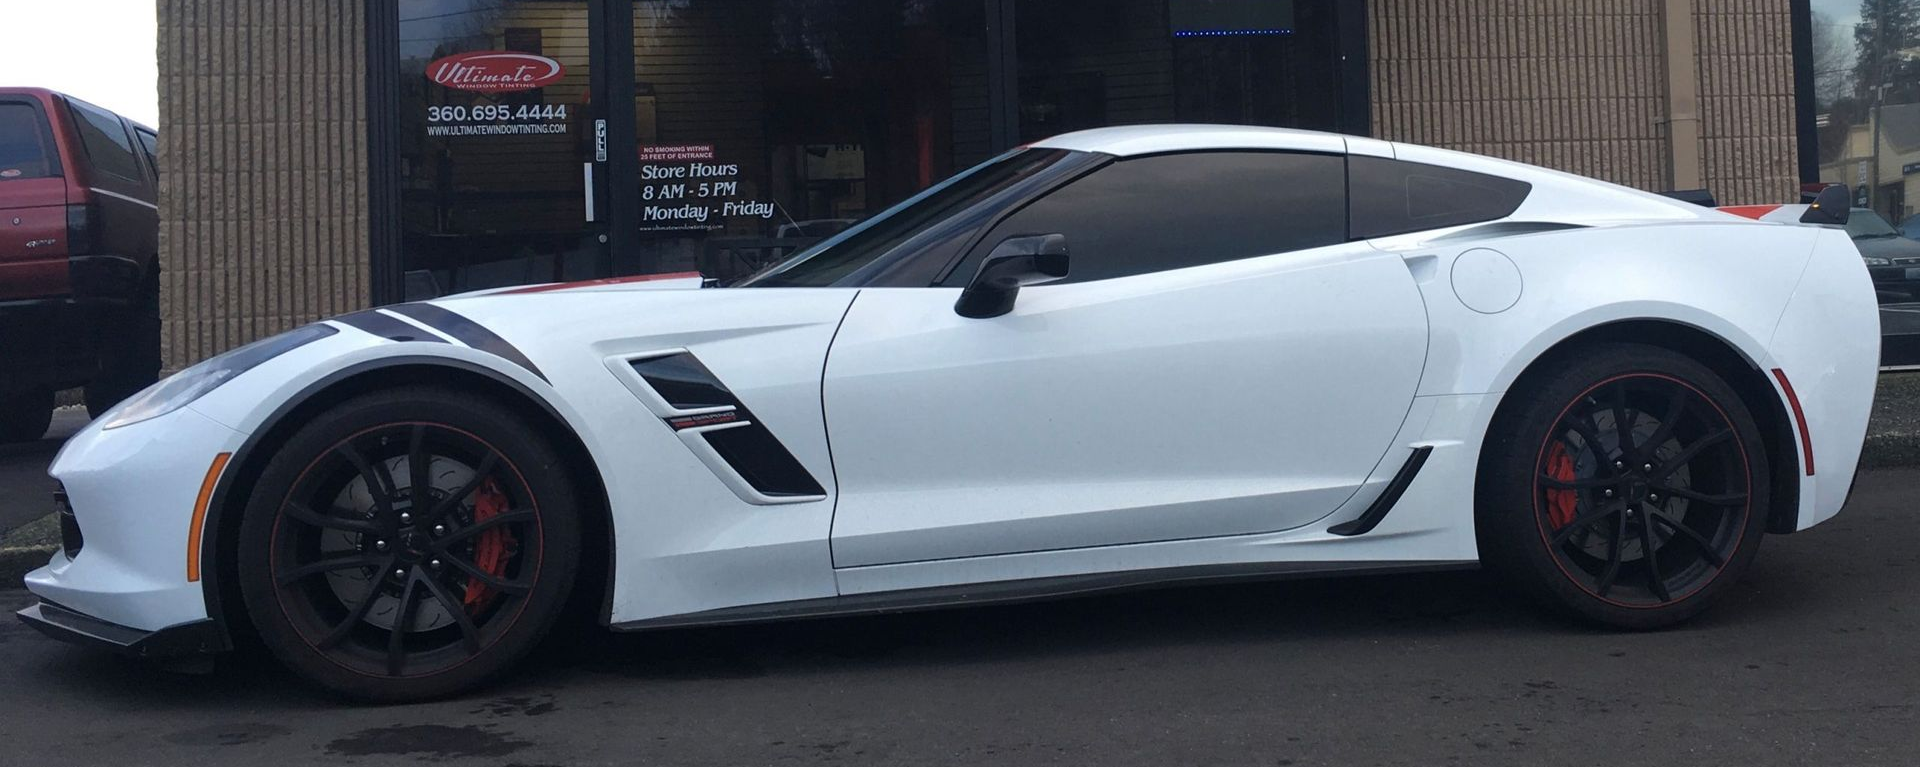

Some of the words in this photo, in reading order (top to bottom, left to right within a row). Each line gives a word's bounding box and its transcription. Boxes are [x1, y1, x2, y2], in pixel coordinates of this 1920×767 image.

[435, 62, 536, 84] Ultimate
[427, 104, 567, 122] 360.695.4444
[427, 124, 566, 136] WWW.ULTIMATEWINDOWTINTING.COM
[597, 123, 605, 151] PULL
[641, 165, 685, 180] Store
[689, 163, 738, 178] Hours
[642, 185, 654, 200] 8
[658, 184, 685, 199] AM
[697, 183, 709, 197] 5
[713, 181, 737, 196] PM
[643, 204, 708, 222] Monday
[722, 200, 774, 218] Friday
